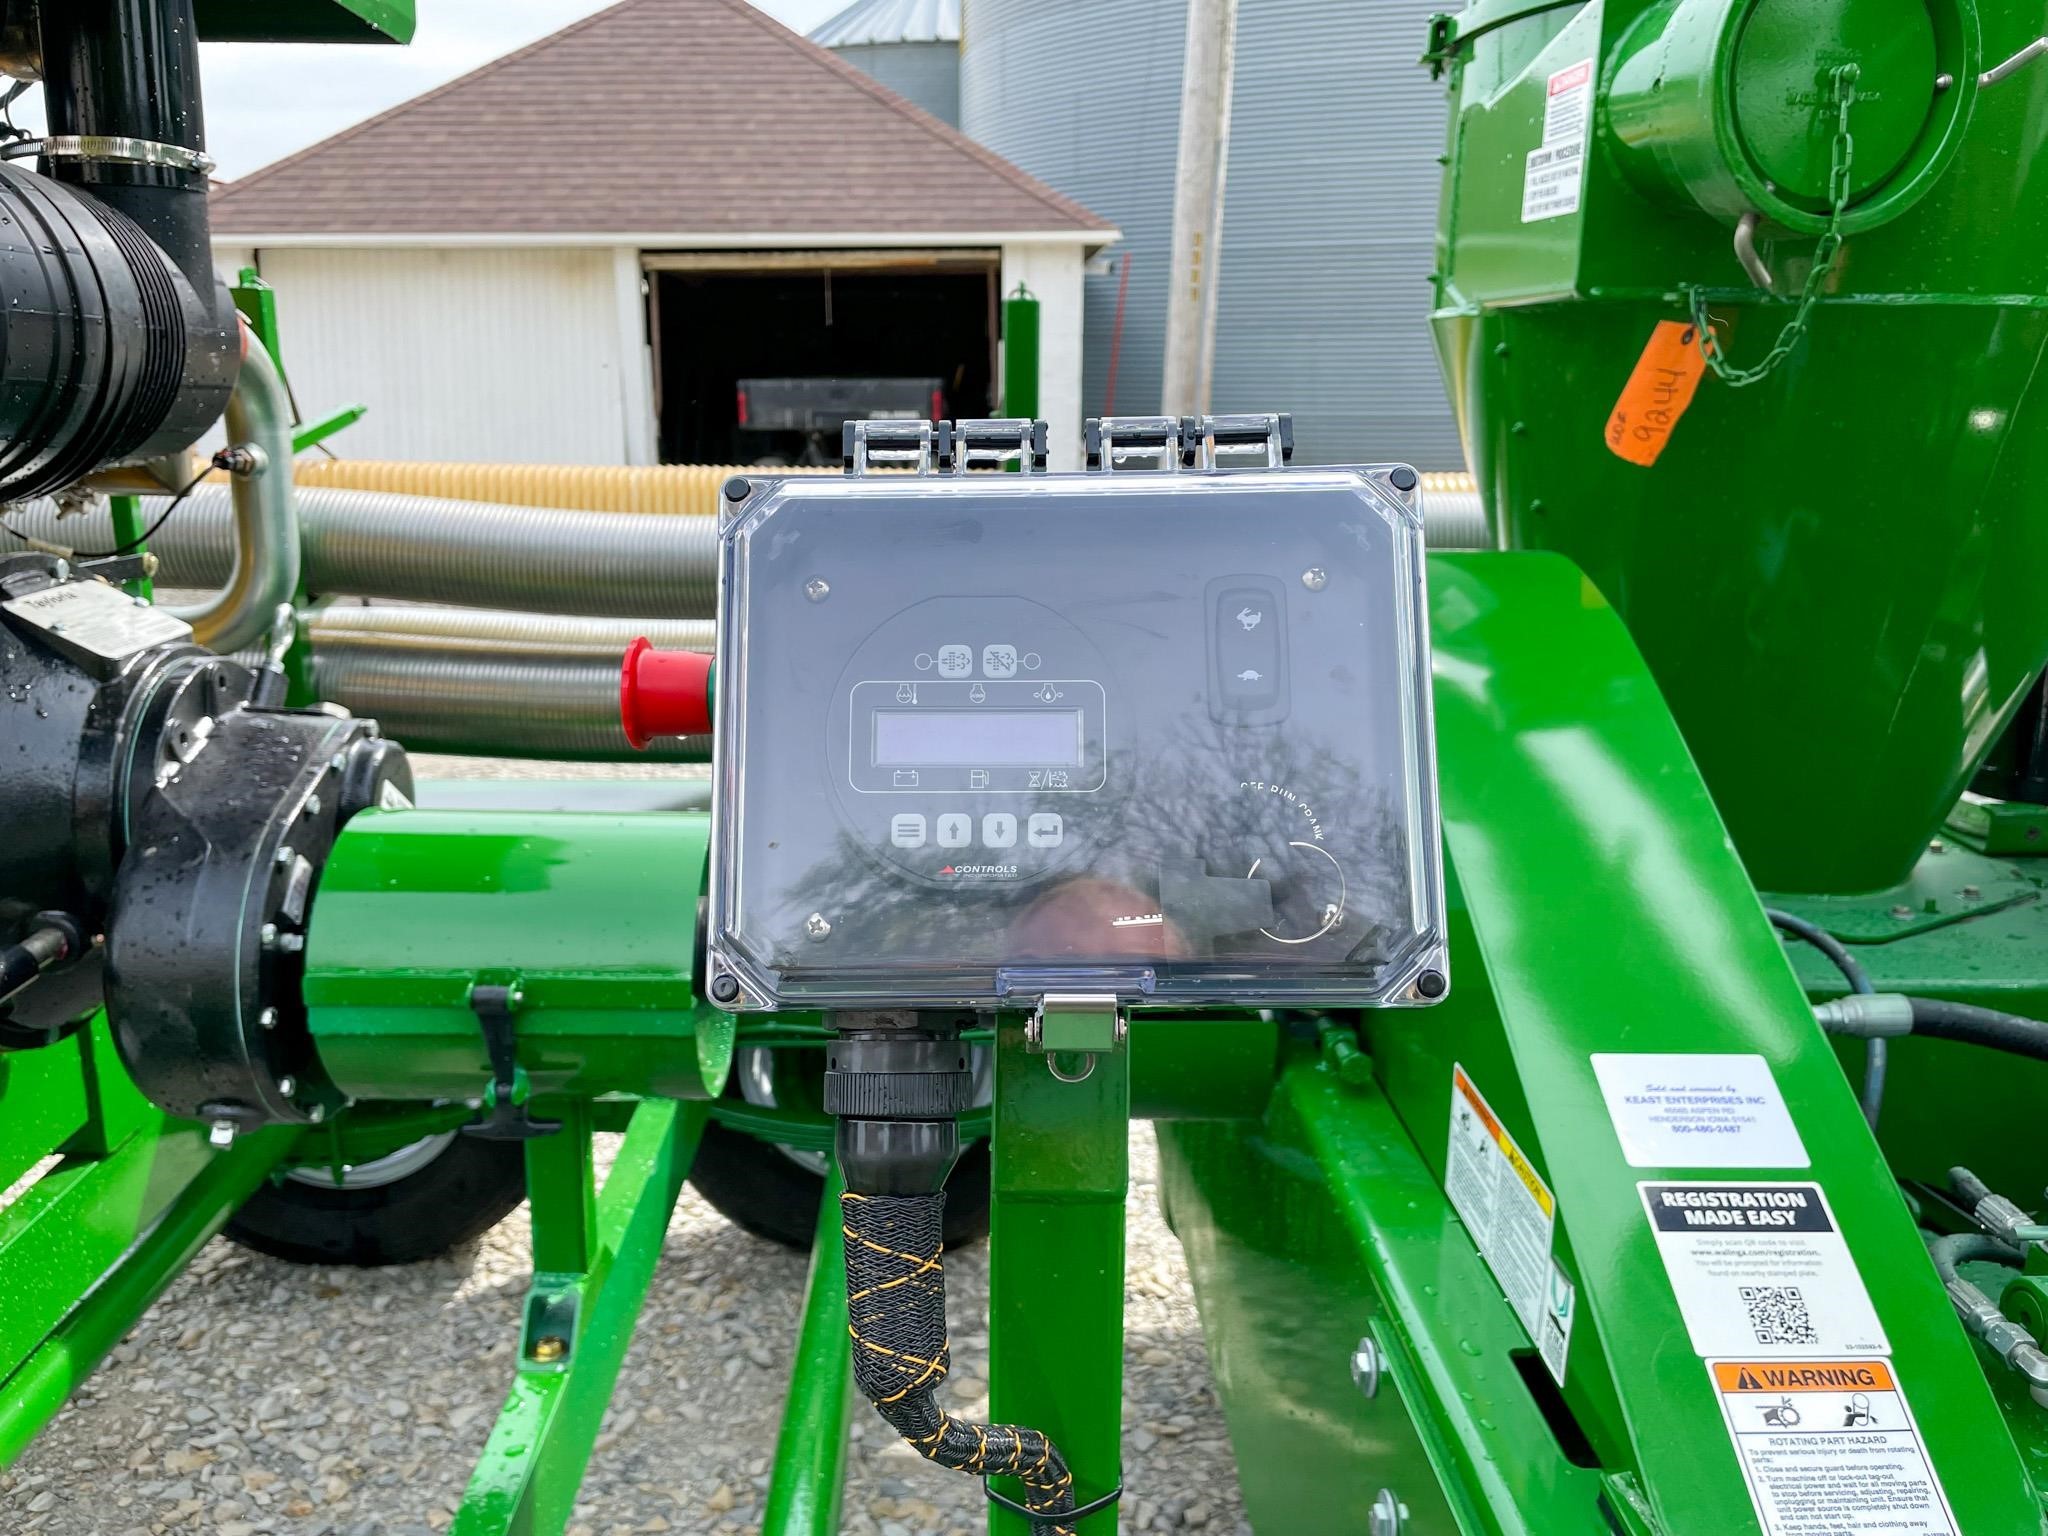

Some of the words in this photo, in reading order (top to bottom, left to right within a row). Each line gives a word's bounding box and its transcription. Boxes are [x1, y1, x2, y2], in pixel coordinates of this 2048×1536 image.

[1632, 368, 1687, 441] 9244
[954, 865, 1018, 873] CONTROLS
[1624, 1096, 1662, 1105] KEAST
[1664, 1096, 1744, 1105] ENTERPRISES
[1661, 1192, 1807, 1207] REGISTRATION
[1684, 1210, 1746, 1225] MADE
[1746, 1210, 1796, 1225] EASY
[1762, 1369, 1876, 1387] WARNING
[1768, 1437, 1818, 1446] ROTATING
[1820, 1437, 1844, 1445] PART
[1847, 1436, 1887, 1444] HAZARD
[1760, 1449, 1788, 1458] prevent
[1816, 1447, 1837, 1456] injury
[1888, 1446, 1915, 1454] rotating
[1824, 1465, 1844, 1473] guard
[1766, 1474, 1784, 1482] Turn
[1868, 1473, 1894, 1481] tag-out
[1803, 1483, 1826, 1491] power
[1880, 1480, 1908, 1488] moving
[1908, 1479, 1927, 1487] parts
[1781, 1490, 1798, 1499] stop
[1798, 1489, 1823, 1497] before
[1775, 1498, 1816, 1507] unplugging
[1826, 1496, 1869, 1504] maintaining
[1887, 1494, 1914, 1502] Ensure
[1793, 1506, 1816, 1514] power
[1843, 1503, 1850, 1511] is
[1851, 1503, 1891, 1512] completely
[1892, 1502, 1909, 1510] shut
[1783, 1522, 1802, 1531] Keep
[1862, 1520, 1877, 1528] and
[1878, 1519, 1909, 1529] clothing
[1909, 1519, 1928, 1528] away
